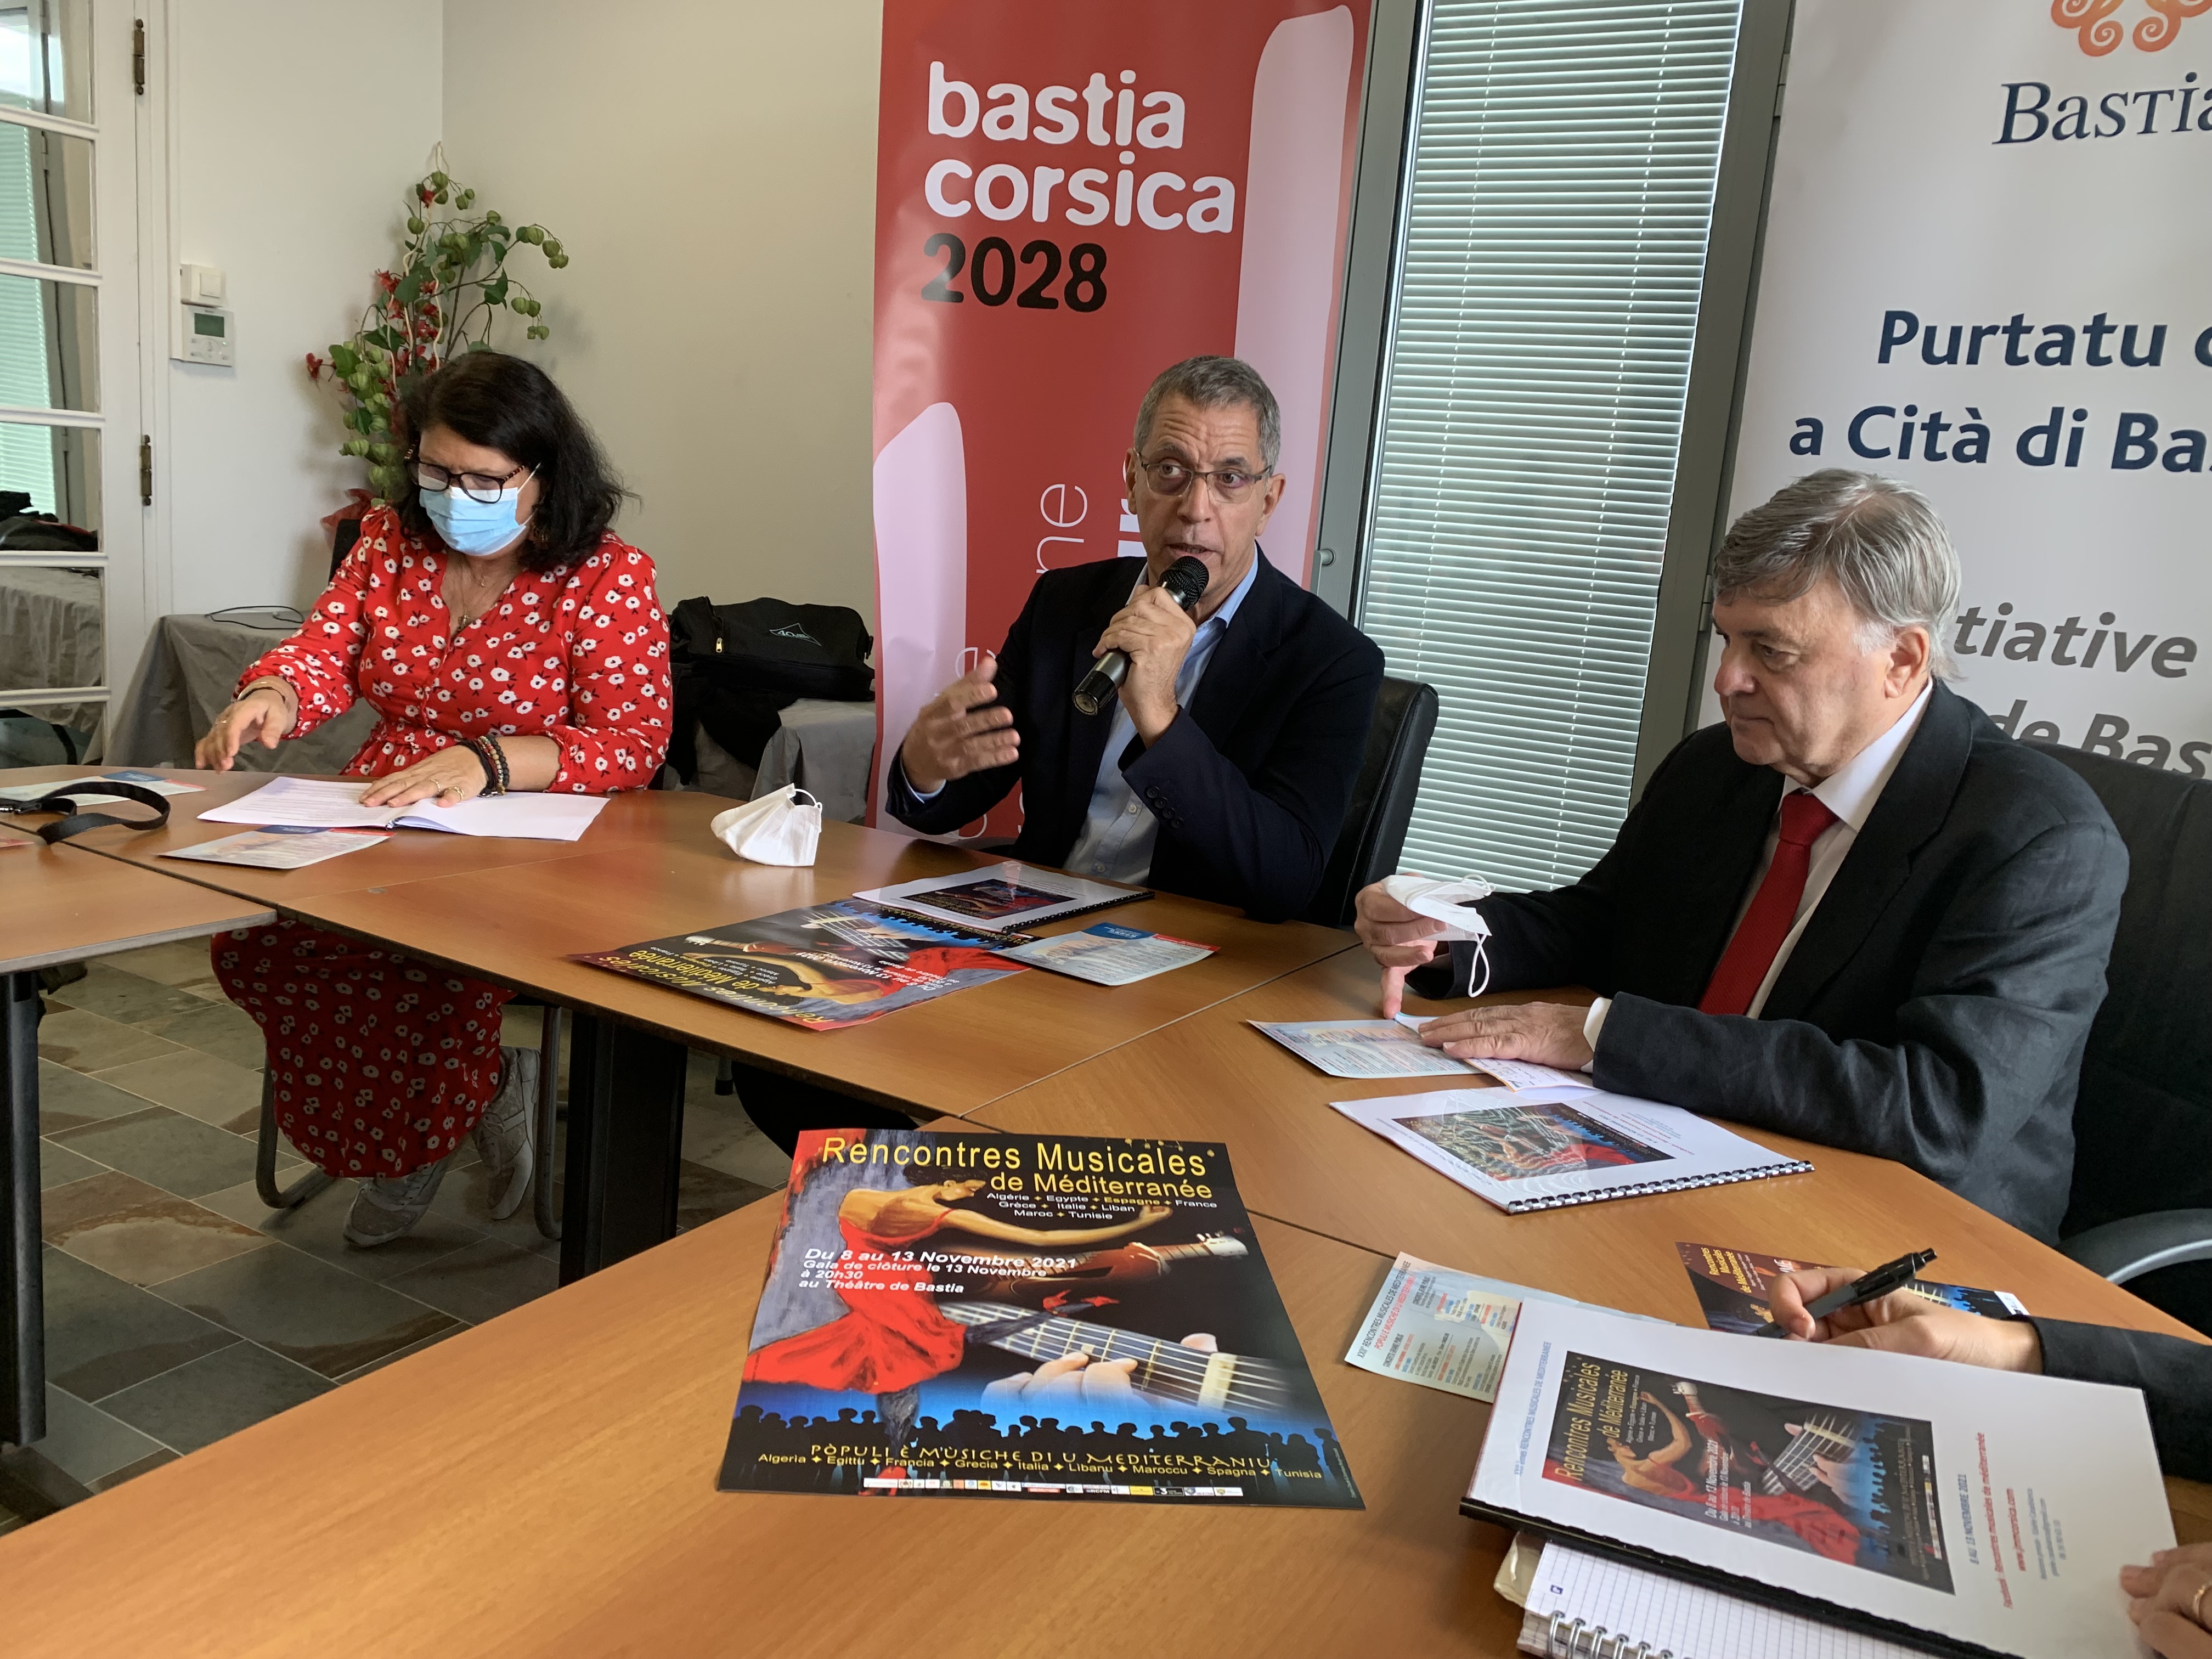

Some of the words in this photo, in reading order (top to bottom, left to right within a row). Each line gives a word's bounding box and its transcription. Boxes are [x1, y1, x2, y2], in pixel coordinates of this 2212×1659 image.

[928, 61, 1185, 149] bastia
[924, 150, 1235, 233] corsica
[921, 233, 1107, 312] 2028
[1878, 310, 2168, 367] Purtatu
[1790, 416, 1824, 456] a
[1848, 404, 1991, 464] Cità
[2016, 407, 2089, 468] di
[2111, 412, 2212, 473] Ba
[1954, 602, 2198, 678] tiative
[2080, 713, 2212, 779] Bas
[599, 956, 707, 986] Musicales
[629, 950, 737, 984] Méditerranée
[732, 980, 759, 990] de
[703, 987, 834, 1024] Rencontres
[822, 1137, 1021, 1169] Rencontres
[1037, 1143, 1206, 1176] Musicales
[986, 1192, 1029, 1201] Algérie
[1046, 1195, 1088, 1204] Egypte
[1104, 1197, 1160, 1206] Espagne
[1175, 1199, 1217, 1208] France
[990, 1171, 1023, 1191] de
[1034, 1173, 1212, 1199] Méditerranée
[998, 1201, 1036, 1209] Grèce
[1101, 1204, 1135, 1212] Liban
[1068, 1211, 1113, 1220] Tunisie
[803, 1260, 839, 1269] Gala
[843, 1261, 863, 1270] de
[867, 1262, 922, 1272] clôture
[927, 1263, 940, 1272] le
[946, 1264, 963, 1273] 13
[967, 1266, 1047, 1277] Novembre
[805, 1248, 834, 1260] Du
[840, 1250, 854, 1261] 8
[858, 1252, 884, 1261] au
[891, 1251, 914, 1262] 13
[920, 1251, 1025, 1267] Novembre
[1031, 1257, 1076, 1269] 2021
[1701, 1247, 1720, 1276] Rencontres
[1713, 1249, 1731, 1274] Musicales
[799, 1280, 819, 1288] au
[826, 1279, 885, 1290] Théâtre
[889, 1282, 910, 1291] de
[914, 1282, 964, 1293] Bastia
[800, 1269, 810, 1278] à
[815, 1270, 864, 1280] 20h30
[1390, 1259, 1412, 1291] MEDITERRANEE
[1376, 1293, 1394, 1320] MUSICALES
[1387, 1288, 1397, 1297] DE
[1361, 1316, 1383, 1348] RENCONTRES
[1567, 1363, 1601, 1417] Musicales
[1598, 1370, 1628, 1426] Méditerranée
[1519, 1415, 1535, 1451] RENCONTRES
[1596, 1425, 1620, 1438] de
[1031, 1451, 1051, 1462] DI
[1063, 1453, 1076, 1463] U
[1086, 1453, 1271, 1468] MEDITERRANIU
[1554, 1417, 1592, 1481] Rencontres
[758, 1453, 806, 1464] Algeria
[827, 1455, 865, 1466] Egittu
[885, 1457, 934, 1468] Francia
[955, 1460, 998, 1469] Grecia
[1018, 1462, 1049, 1471] Italia
[1069, 1463, 1113, 1472] Libanu
[1132, 1465, 1188, 1475] Maroccu
[1207, 1466, 1256, 1477] Spagna
[1274, 1469, 1322, 1479] Tunisia
